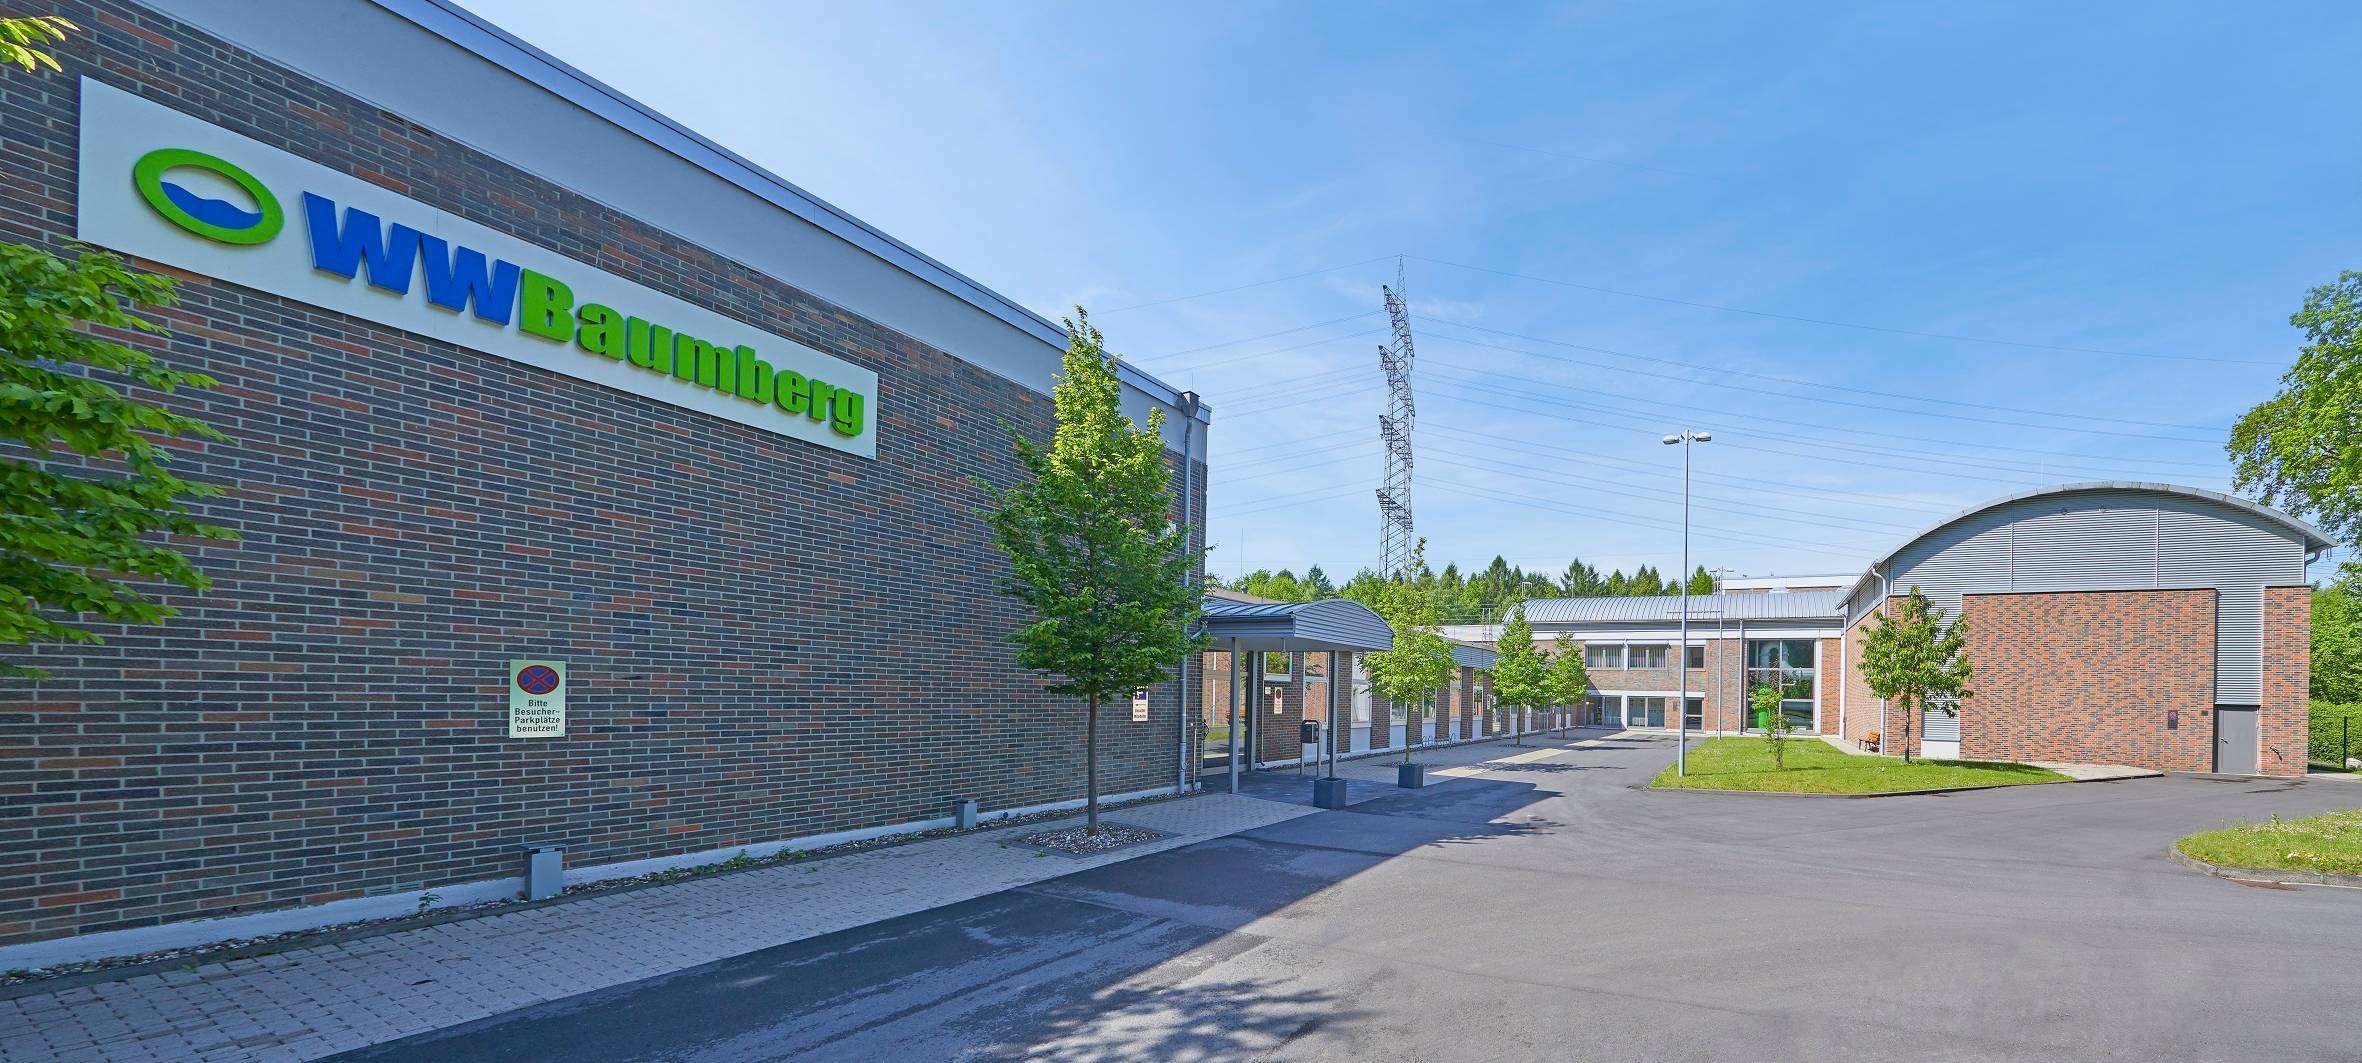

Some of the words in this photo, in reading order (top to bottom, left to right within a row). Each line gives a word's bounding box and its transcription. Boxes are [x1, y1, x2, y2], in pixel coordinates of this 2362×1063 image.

[514, 708, 560, 716] Besucher-
[514, 716, 561, 724] Parkplätze
[516, 724, 558, 732] benutzen!
